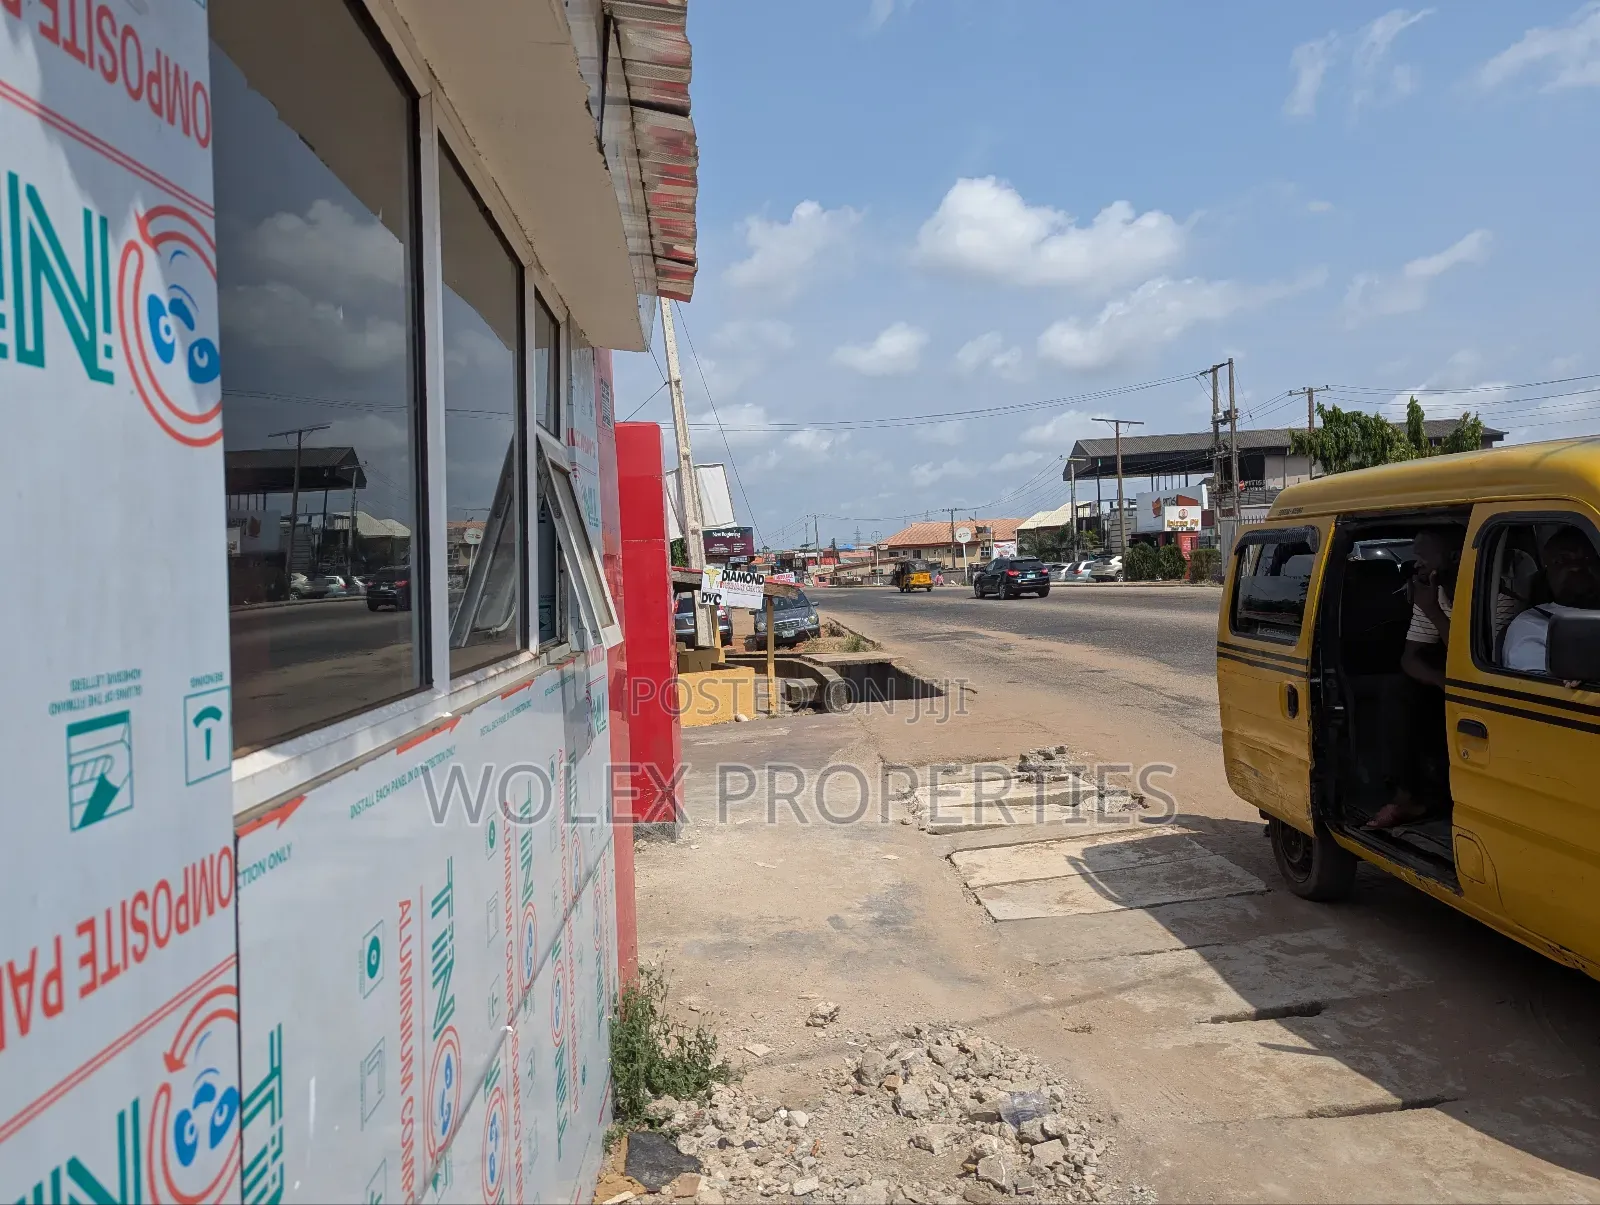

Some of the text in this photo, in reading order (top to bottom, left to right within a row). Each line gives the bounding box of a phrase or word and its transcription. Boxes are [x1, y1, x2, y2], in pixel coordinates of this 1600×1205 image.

[38, 0, 211, 148] OMPOSITE
[701, 592, 722, 606] DVC
[721, 570, 765, 585] DIAMOND
[268, 842, 294, 871] ONLY
[75, 846, 235, 1000] OMPOSITE
[398, 899, 414, 1096] ALUMINIUM
